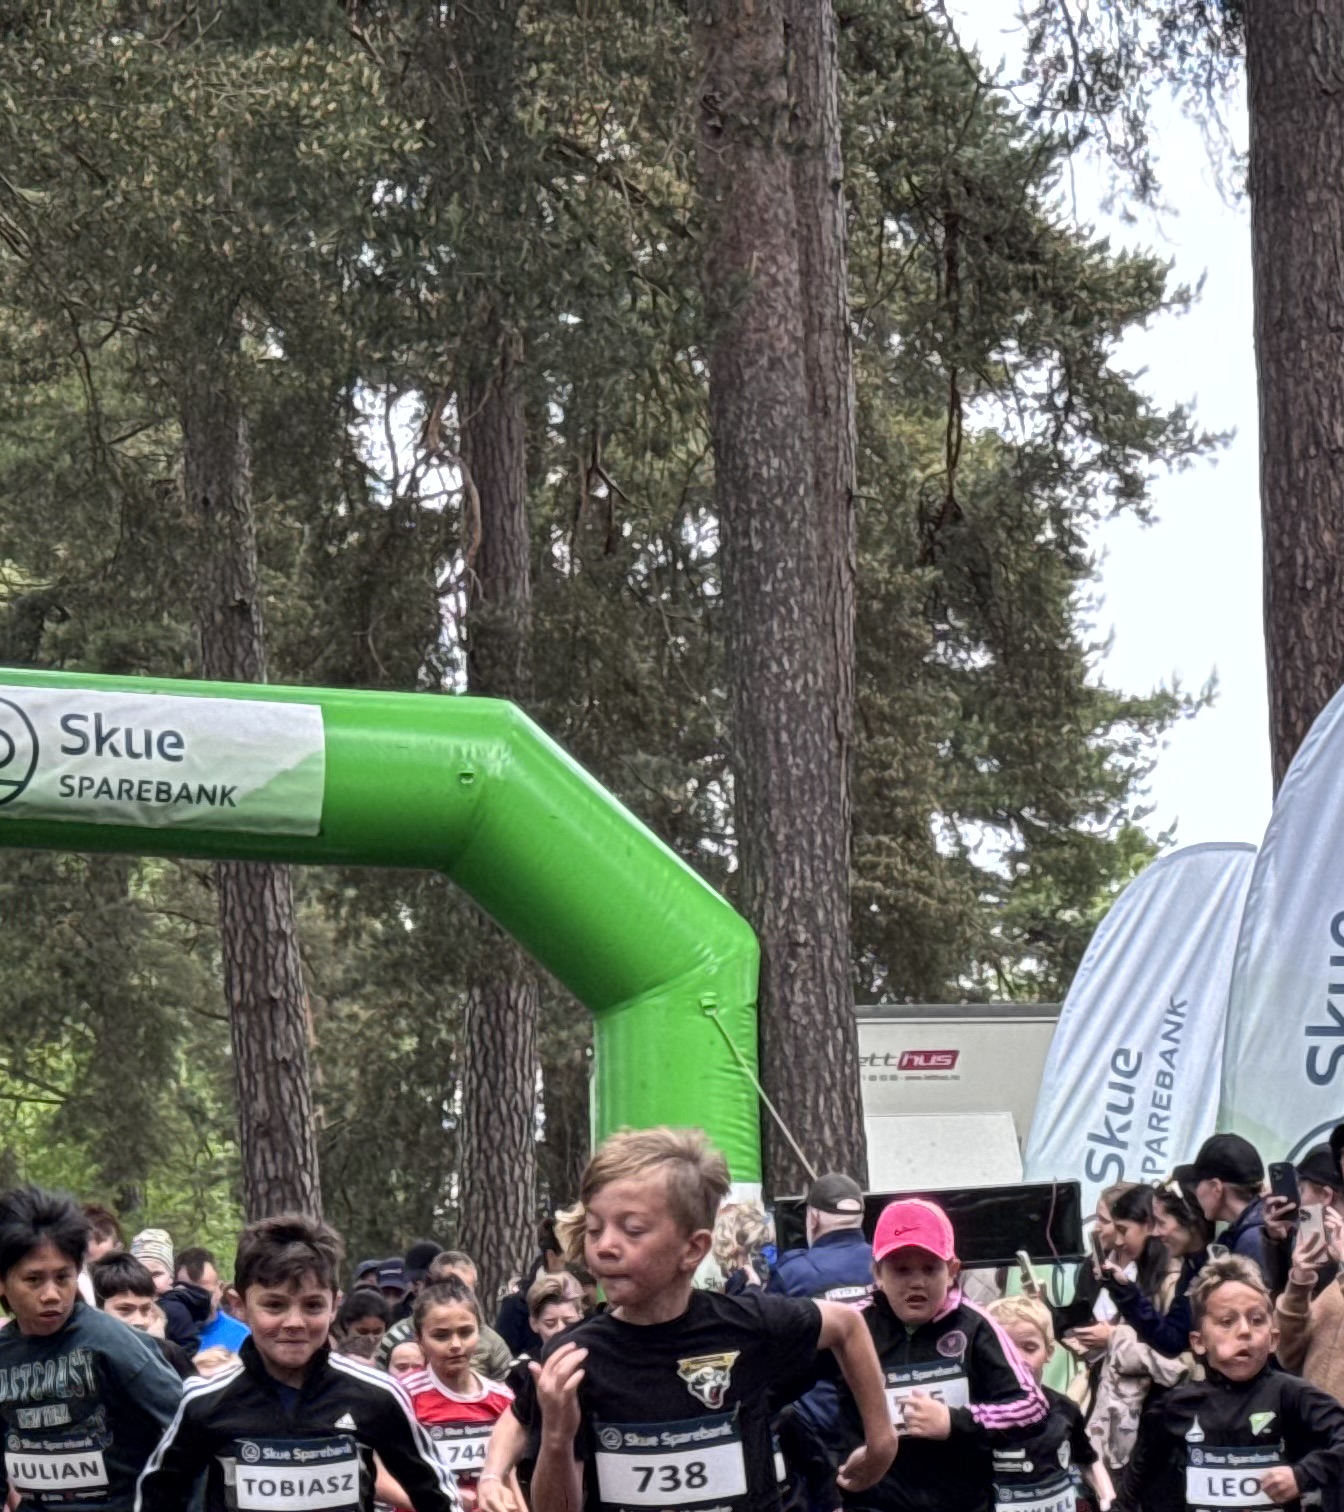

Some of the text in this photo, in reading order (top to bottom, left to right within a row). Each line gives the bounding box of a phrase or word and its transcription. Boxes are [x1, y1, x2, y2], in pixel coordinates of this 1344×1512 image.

[60, 712, 185, 762] Skue
[59, 774, 238, 808] SPAREBANK
[1085, 1047, 1143, 1185] Skue
[447, 1443, 486, 1463] 744
[12, 1460, 100, 1481] JULIAN
[631, 1461, 709, 1493] 738
[241, 1473, 355, 1497] TOBIASZ
[1207, 1476, 1262, 1498] LEO
